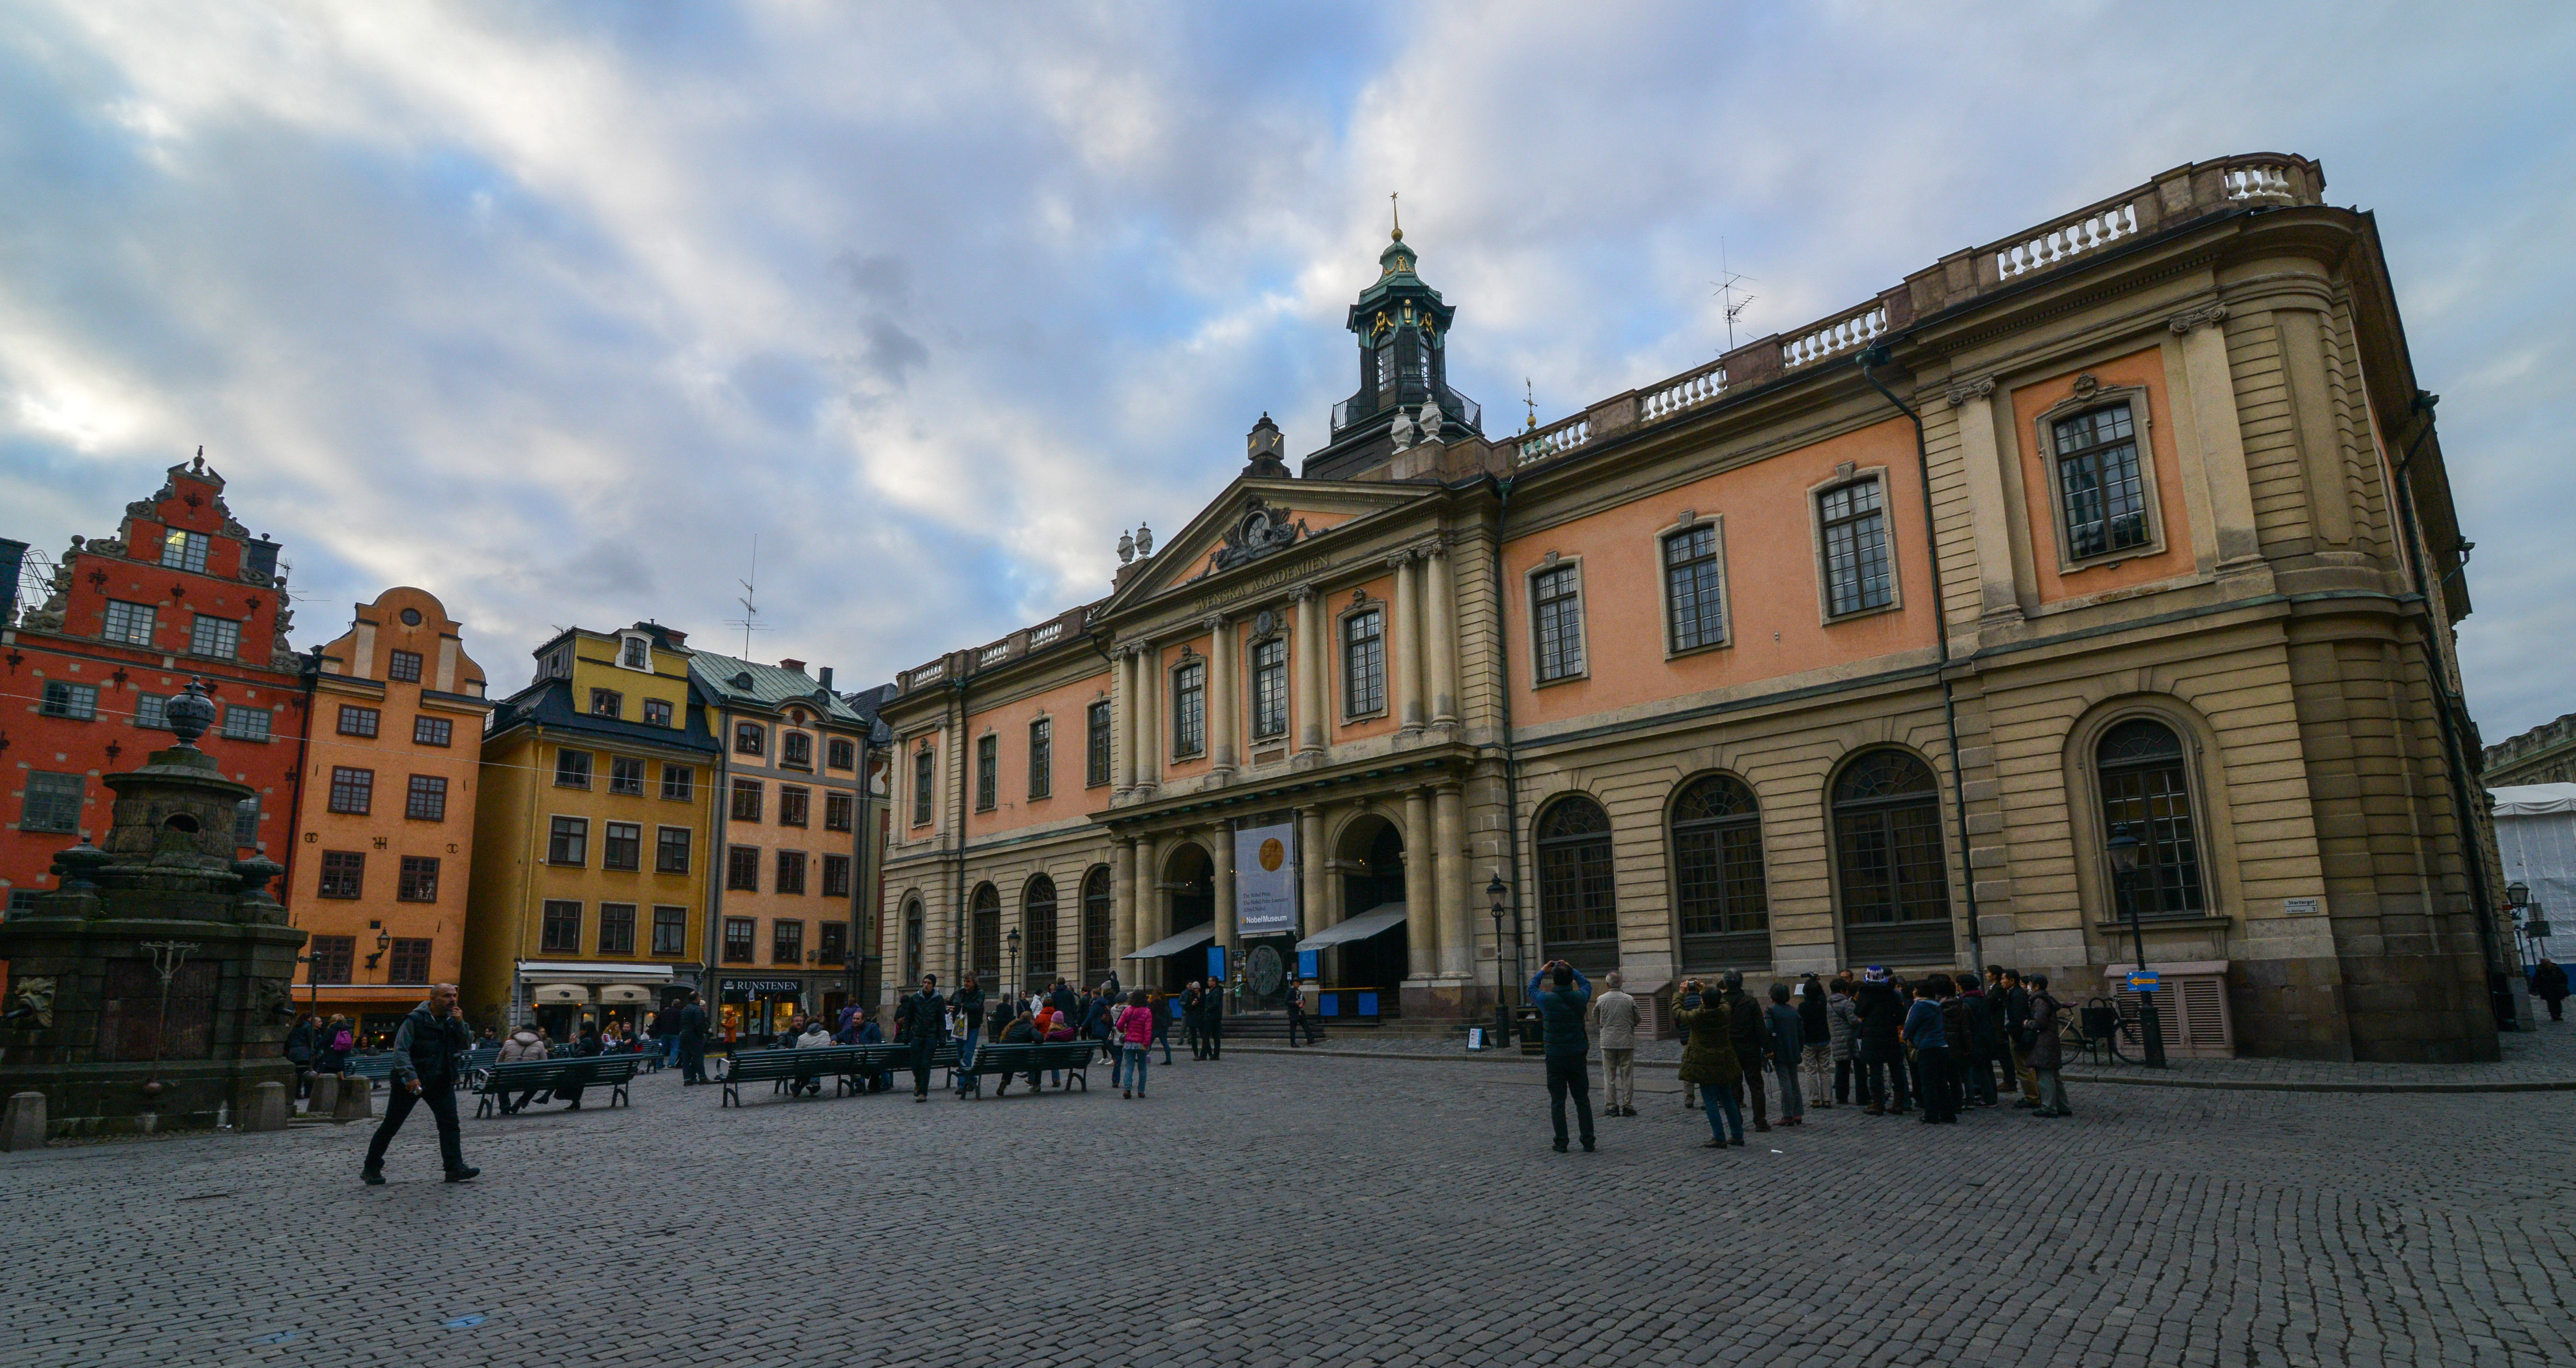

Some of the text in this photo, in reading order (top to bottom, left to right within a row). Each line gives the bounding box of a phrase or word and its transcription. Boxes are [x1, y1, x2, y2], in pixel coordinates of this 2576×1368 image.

[1194, 554, 1330, 611] SVENSKA AKADEMIEN
[737, 981, 798, 990] RUNSTENEN
